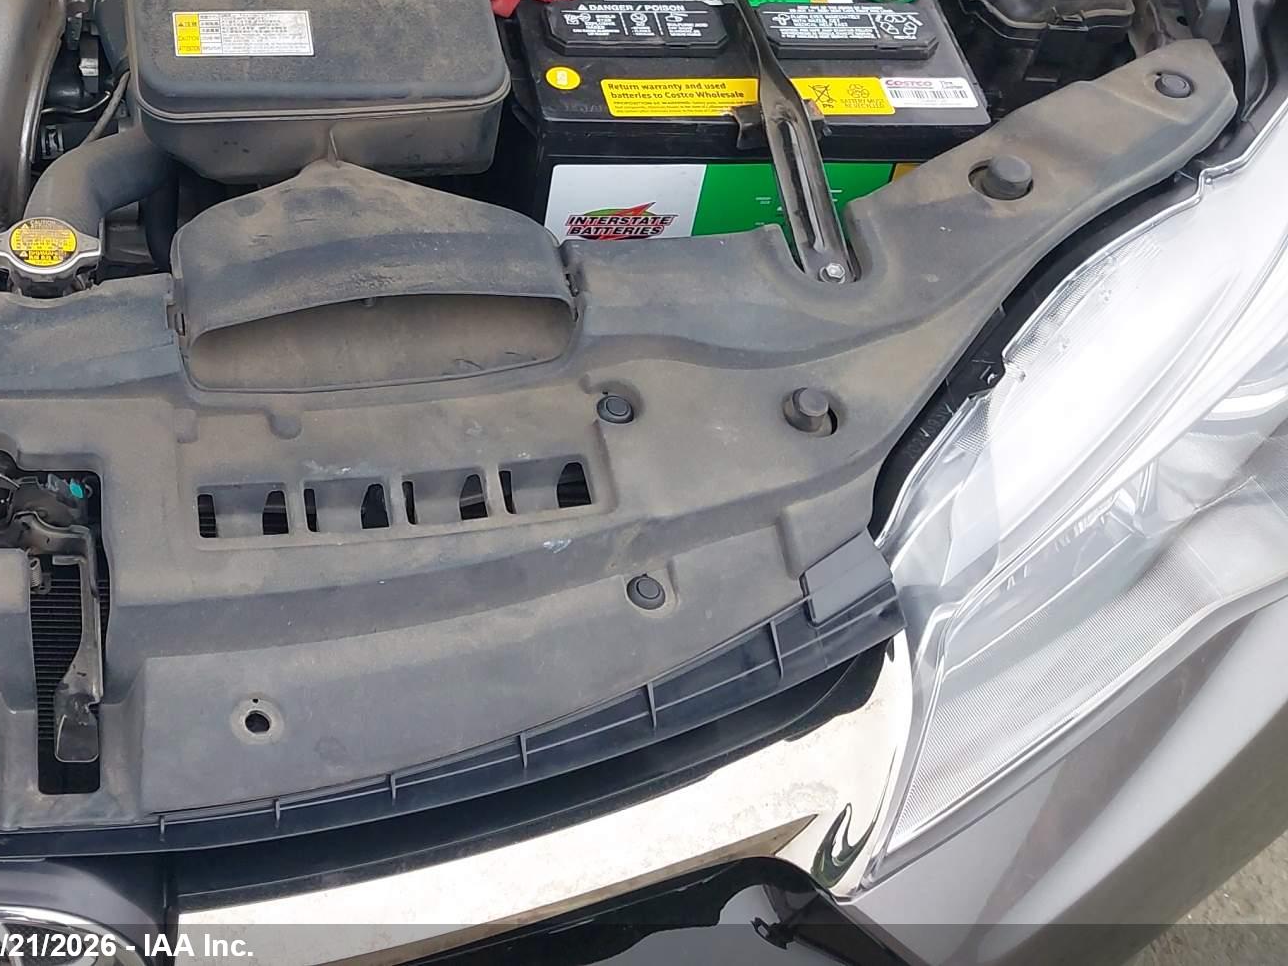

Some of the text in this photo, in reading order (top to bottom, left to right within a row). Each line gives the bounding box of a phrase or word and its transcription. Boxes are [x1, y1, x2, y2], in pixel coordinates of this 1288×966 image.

[685, 82, 702, 90] and
[704, 82, 726, 90] used
[664, 91, 694, 99] Costco
[568, 216, 674, 225] INTERSTATE
[569, 226, 663, 235] BATTERIES
